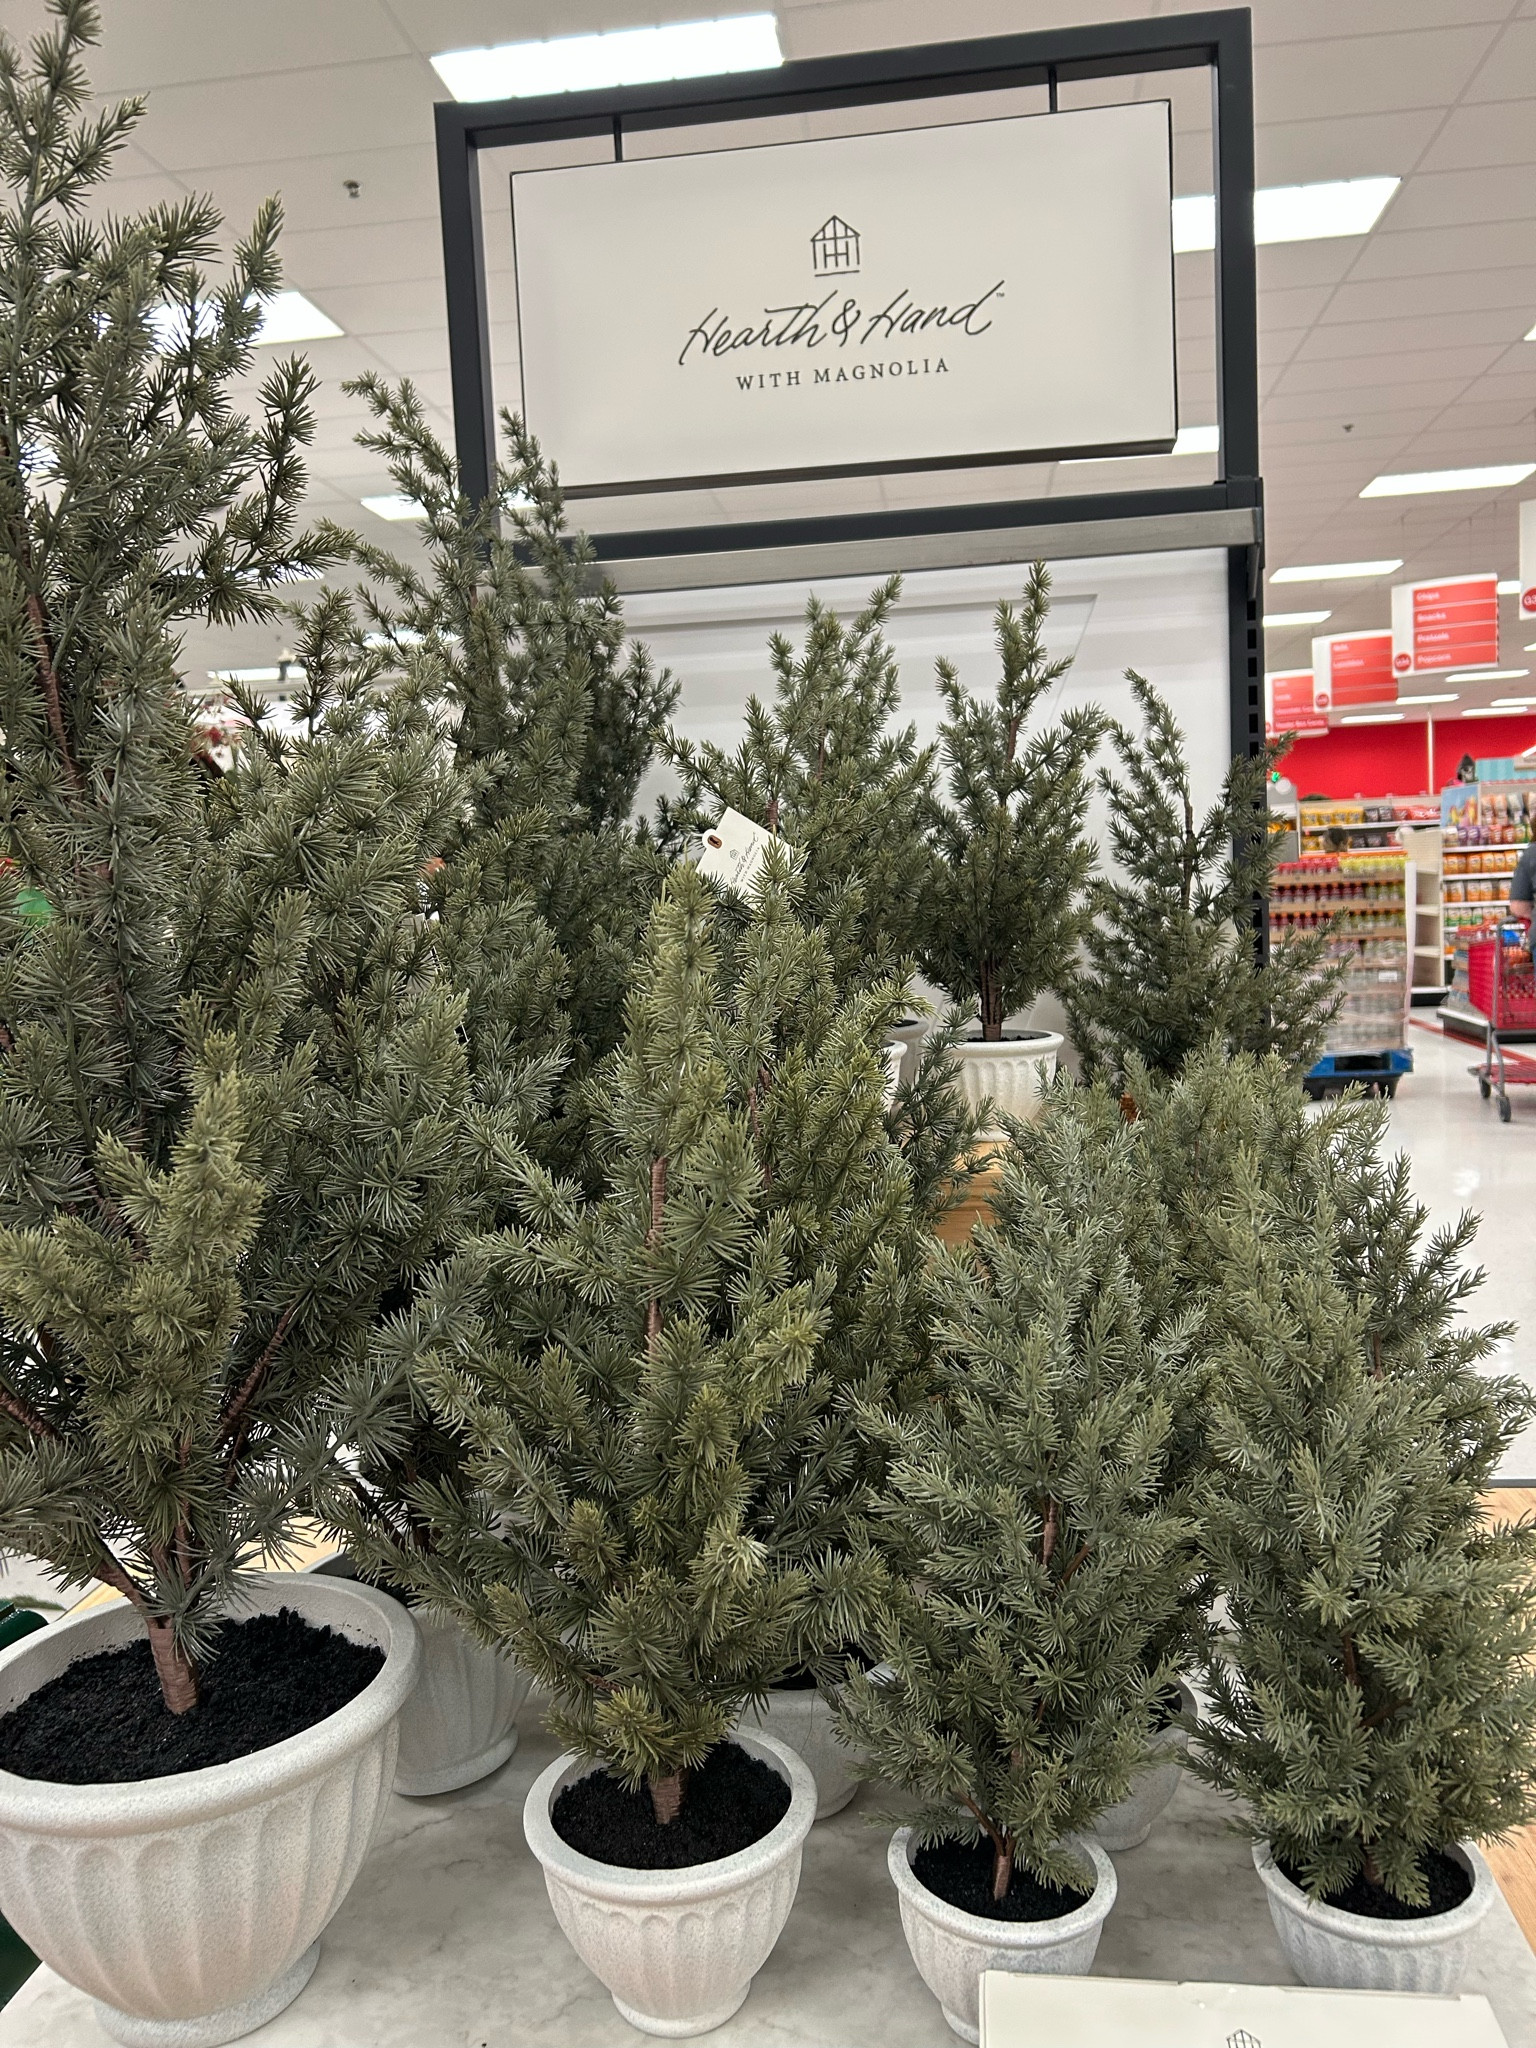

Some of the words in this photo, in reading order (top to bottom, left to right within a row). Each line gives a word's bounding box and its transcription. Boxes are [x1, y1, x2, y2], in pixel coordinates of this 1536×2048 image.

[678, 290, 838, 365] Hearth
[832, 298, 861, 347] &
[736, 370, 802, 390] WITH
[813, 357, 950, 384] MAGNOLIA
